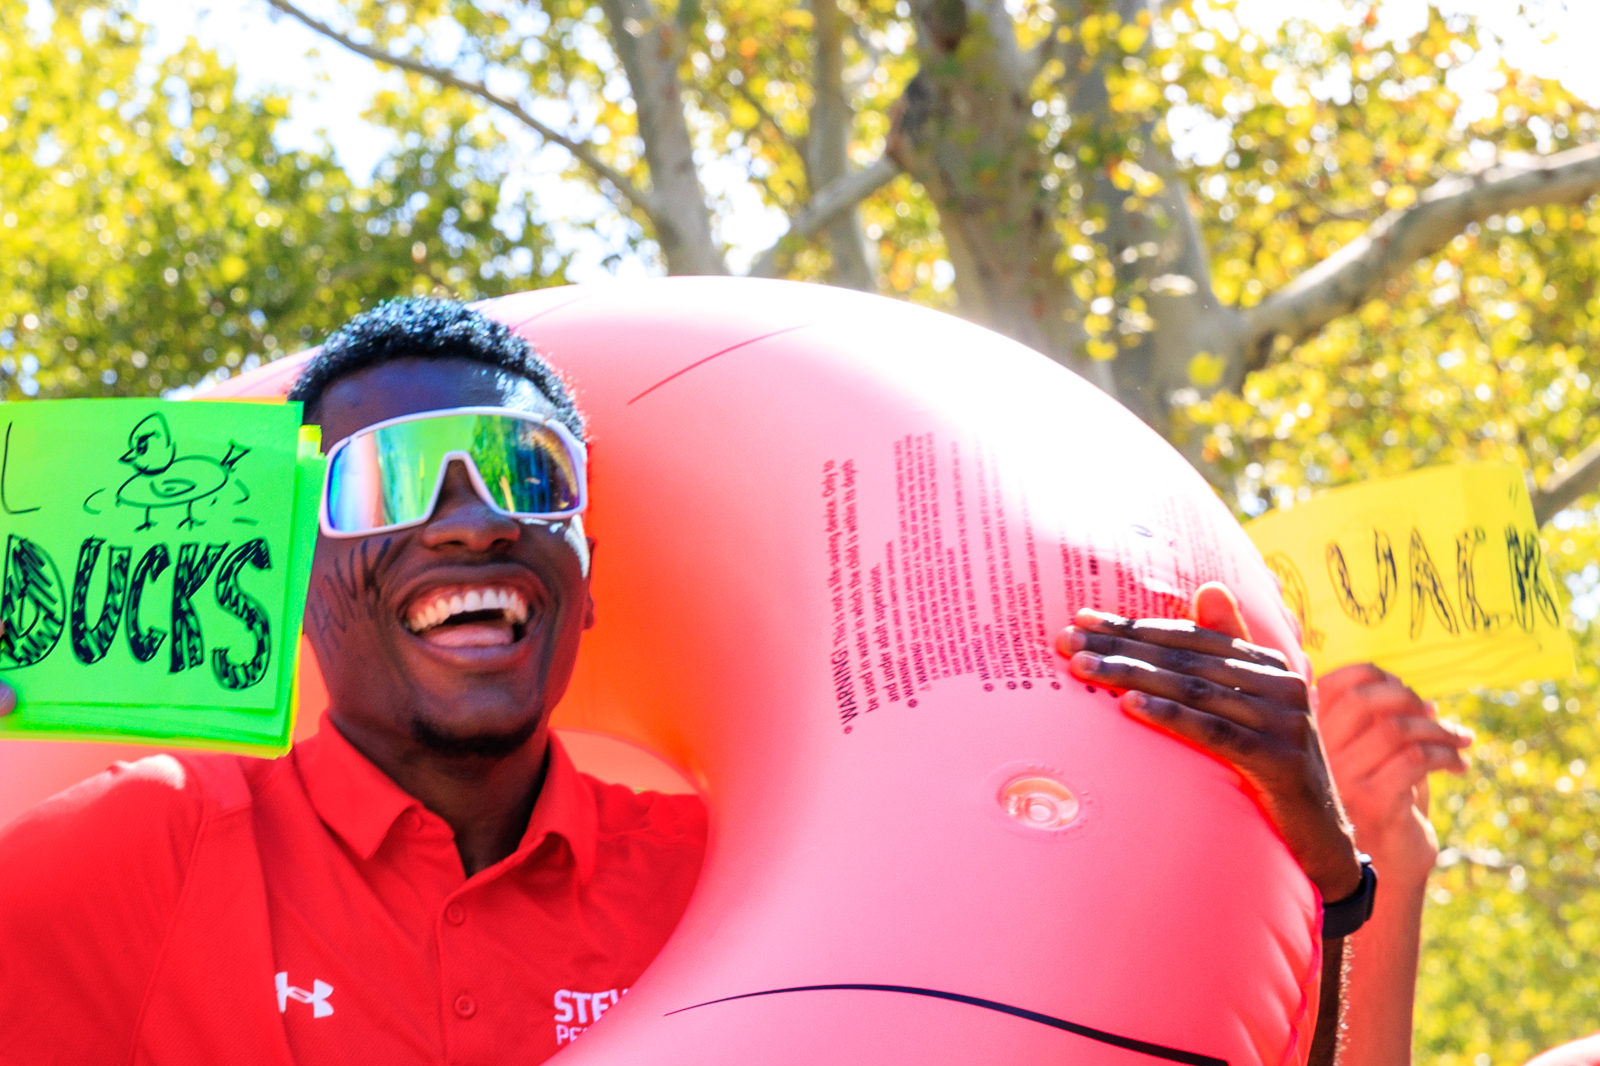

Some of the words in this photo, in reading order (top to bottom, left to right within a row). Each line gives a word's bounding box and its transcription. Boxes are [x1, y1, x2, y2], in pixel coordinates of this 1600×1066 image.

[822, 460, 834, 472] to
[841, 459, 856, 487] depth
[822, 472, 838, 497] Only
[843, 488, 855, 503] its
[844, 503, 857, 533] within
[845, 534, 858, 546] is
[827, 533, 842, 586] life-saving
[845, 544, 860, 568] child
[848, 570, 861, 588] the
[831, 593, 843, 612] not
[849, 588, 864, 617] which
[869, 564, 887, 621] supervision.
[832, 612, 845, 624] is
[853, 618, 865, 631] in
[833, 622, 846, 646] This
[856, 631, 869, 658] water
[873, 623, 889, 649] adult
[858, 659, 871, 672] in
[910, 642, 927, 684] WARNING!
[995, 630, 1015, 677] ATTENTION!
[878, 652, 895, 680] under
[830, 646, 859, 726] WARNING!
[859, 671, 876, 695] used
[882, 682, 900, 702] and
[865, 697, 879, 712] be
